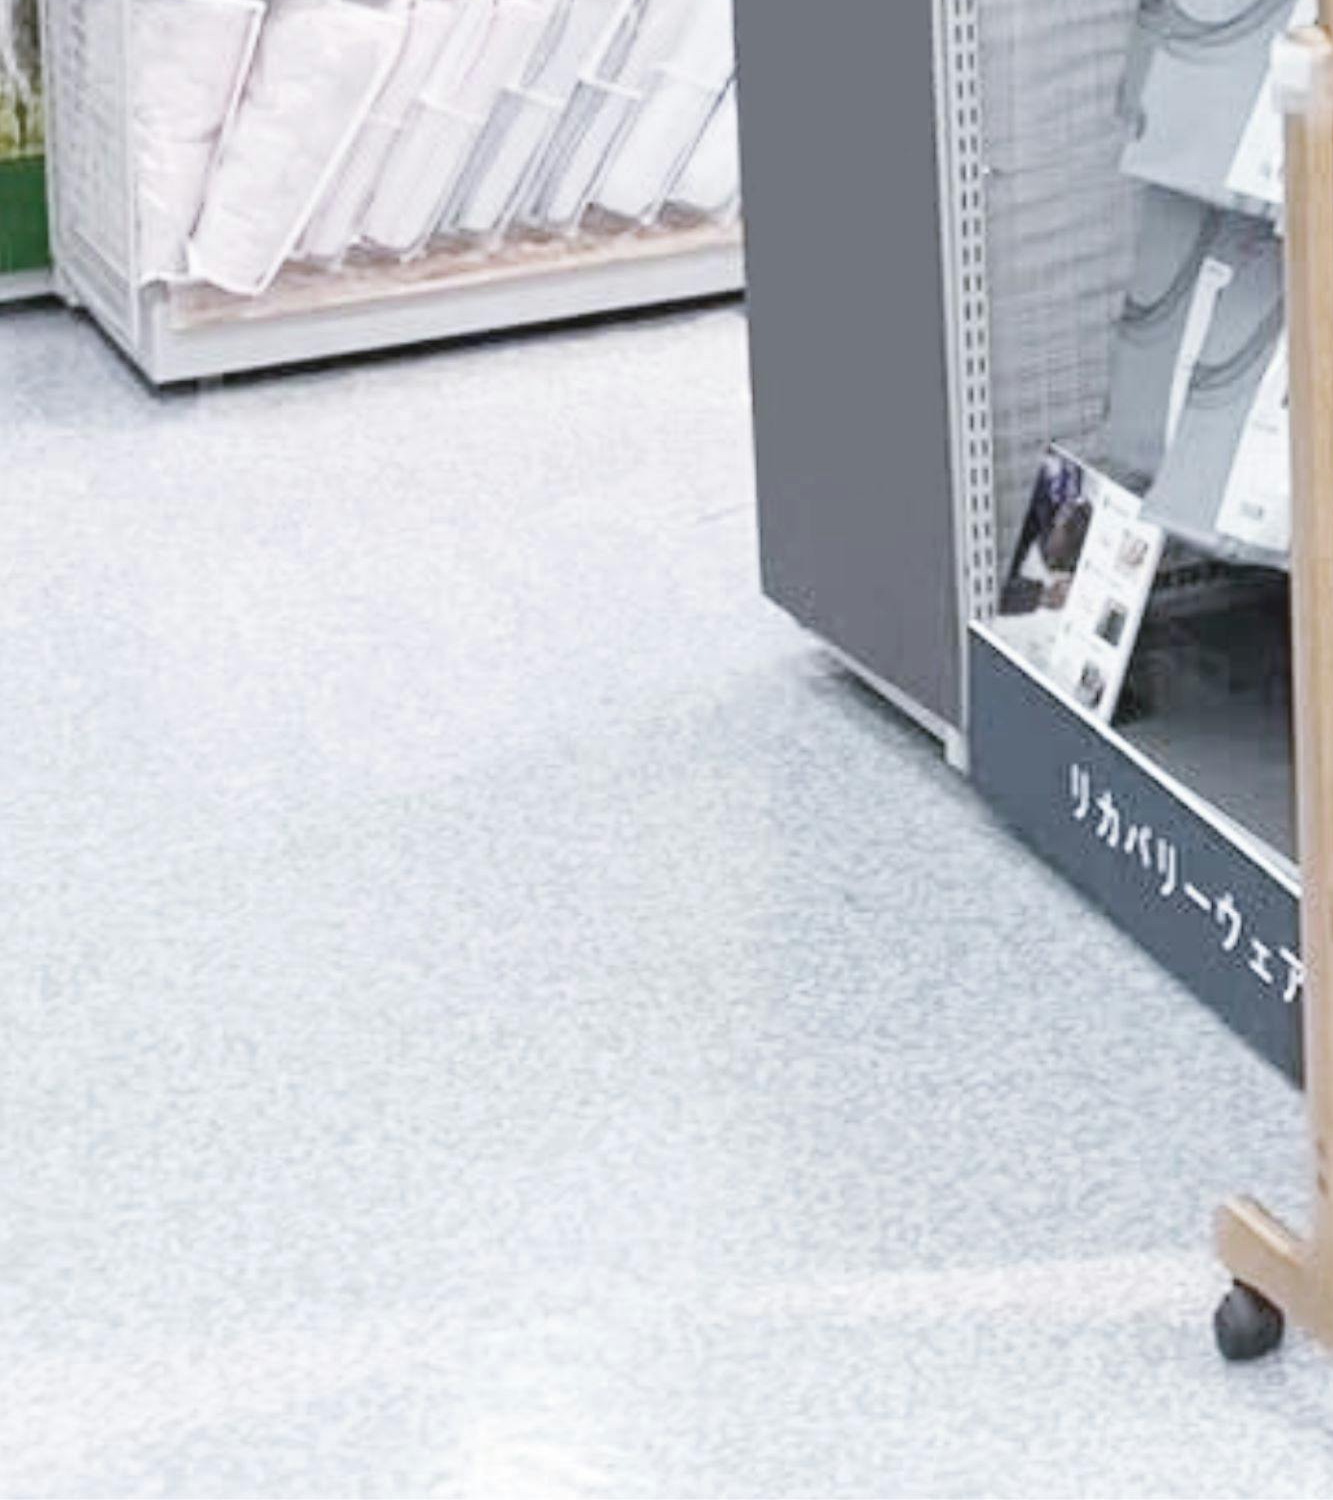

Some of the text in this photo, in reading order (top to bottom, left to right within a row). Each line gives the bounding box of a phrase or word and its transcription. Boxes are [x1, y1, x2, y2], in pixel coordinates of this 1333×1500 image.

[1068, 762, 1305, 1003] リカバリーウェア
